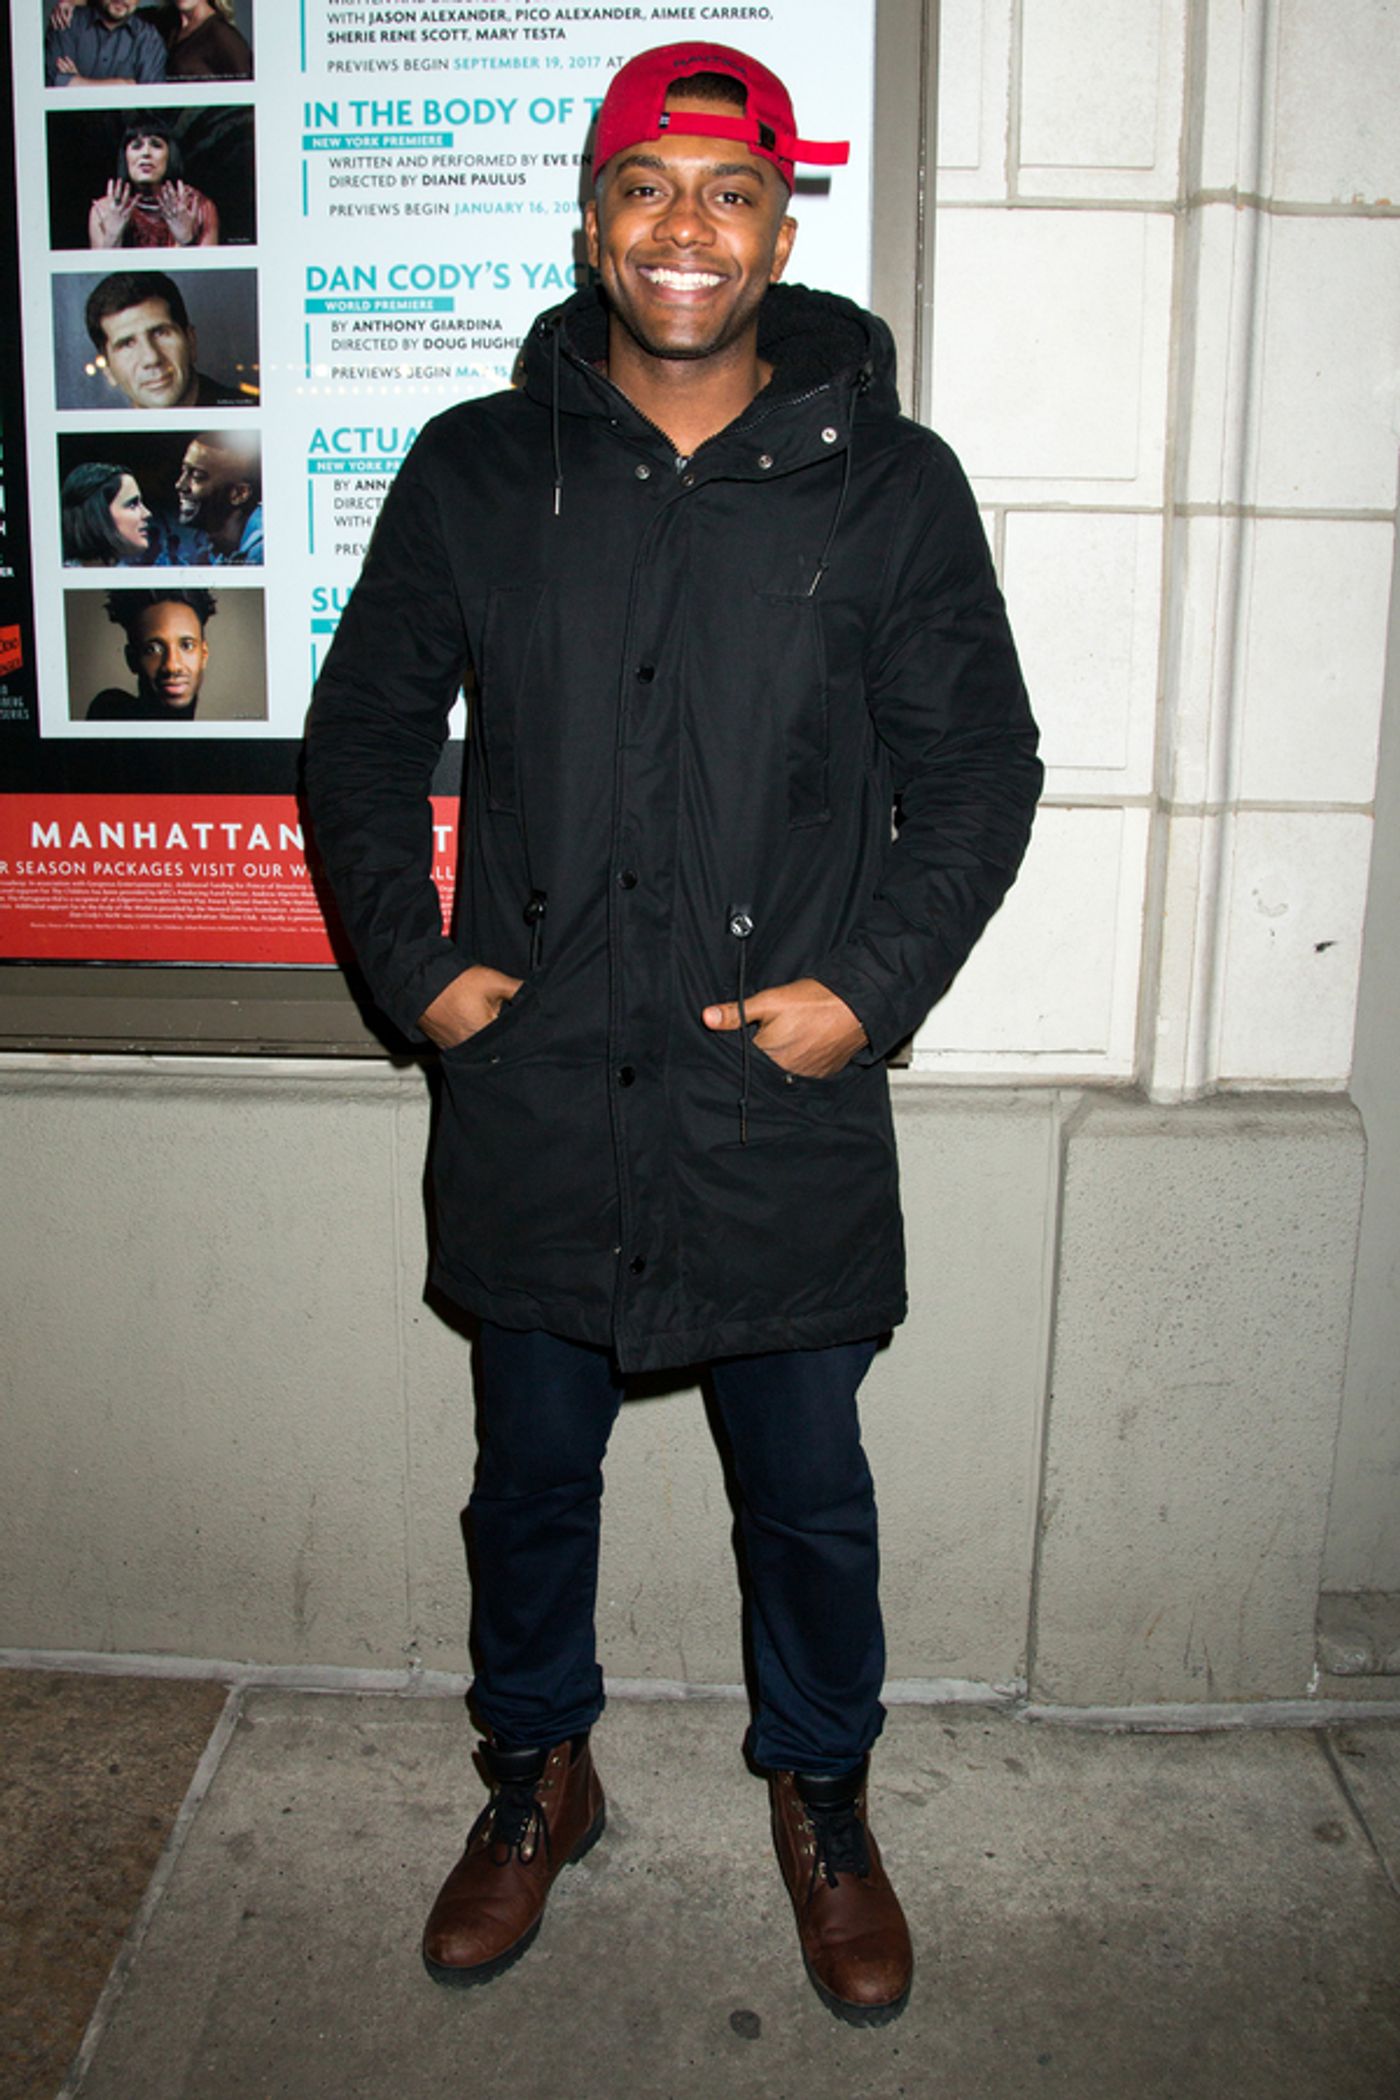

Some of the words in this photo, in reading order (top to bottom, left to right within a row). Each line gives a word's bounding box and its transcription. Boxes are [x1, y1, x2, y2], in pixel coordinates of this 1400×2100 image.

[327, 12, 365, 24] WITH
[369, 11, 417, 26] JASON
[420, 9, 511, 23] ALEXANDER,
[515, 9, 550, 21] PICO
[555, 8, 647, 21] ALEXANDER,
[651, 7, 696, 19] AIMEE
[700, 7, 774, 20] CARRERO,
[327, 31, 376, 44] SHERIE
[380, 30, 417, 43] RENE
[422, 29, 472, 42] SCOTT,
[475, 28, 518, 40] MARY
[524, 28, 566, 40] TESTA
[327, 60, 399, 73] PREVIEWS
[404, 59, 449, 71] BEGIN
[454, 57, 540, 70] SEPTEMBER
[545, 56, 564, 70] 19,
[569, 56, 601, 68] 2017
[606, 56, 623, 68] AT
[304, 101, 339, 129] IN
[349, 99, 412, 127] THE
[423, 98, 518, 126] BODY
[529, 98, 574, 124] OF
[312, 137, 342, 148] NEW
[345, 136, 380, 147] YORK
[383, 135, 443, 147] PREMIERE
[329, 157, 392, 169] WRITTEN
[396, 156, 428, 168] AND
[432, 154, 517, 168] PERFORMED
[520, 154, 538, 166] BY
[543, 154, 568, 166] EVE
[329, 175, 397, 188] DIRECTED
[401, 174, 418, 187] BY
[422, 174, 467, 186] DIANE
[471, 173, 526, 185] PAULUS
[329, 204, 401, 216] PREVIEWS
[405, 203, 449, 215] BEGIN
[454, 201, 523, 215] JANUARY
[529, 201, 548, 214] 16,
[554, 201, 579, 213] 201
[306, 265, 377, 292] DAN
[325, 300, 371, 311] WORLD
[374, 299, 434, 311] PREMIERE
[331, 321, 348, 333] BY
[352, 320, 426, 332] ANTHONY
[430, 319, 503, 331] GIARDINA
[331, 338, 398, 351] DIRECTED
[401, 338, 419, 350] BY
[423, 338, 467, 350] DOUG
[331, 366, 402, 379] PREVIEWS
[456, 365, 488, 378] MA
[316, 461, 345, 472] NEW
[349, 461, 382, 472] YORK
[334, 480, 350, 491] BY
[354, 479, 391, 491] ANN
[334, 515, 371, 527] WITH
[31, 821, 305, 851] MANHATTAN
[15, 861, 87, 875] SEASON
[93, 861, 184, 877] PACKAGES
[190, 862, 236, 877] VISIT
[243, 862, 283, 878] OUR
[430, 865, 456, 880] LL
